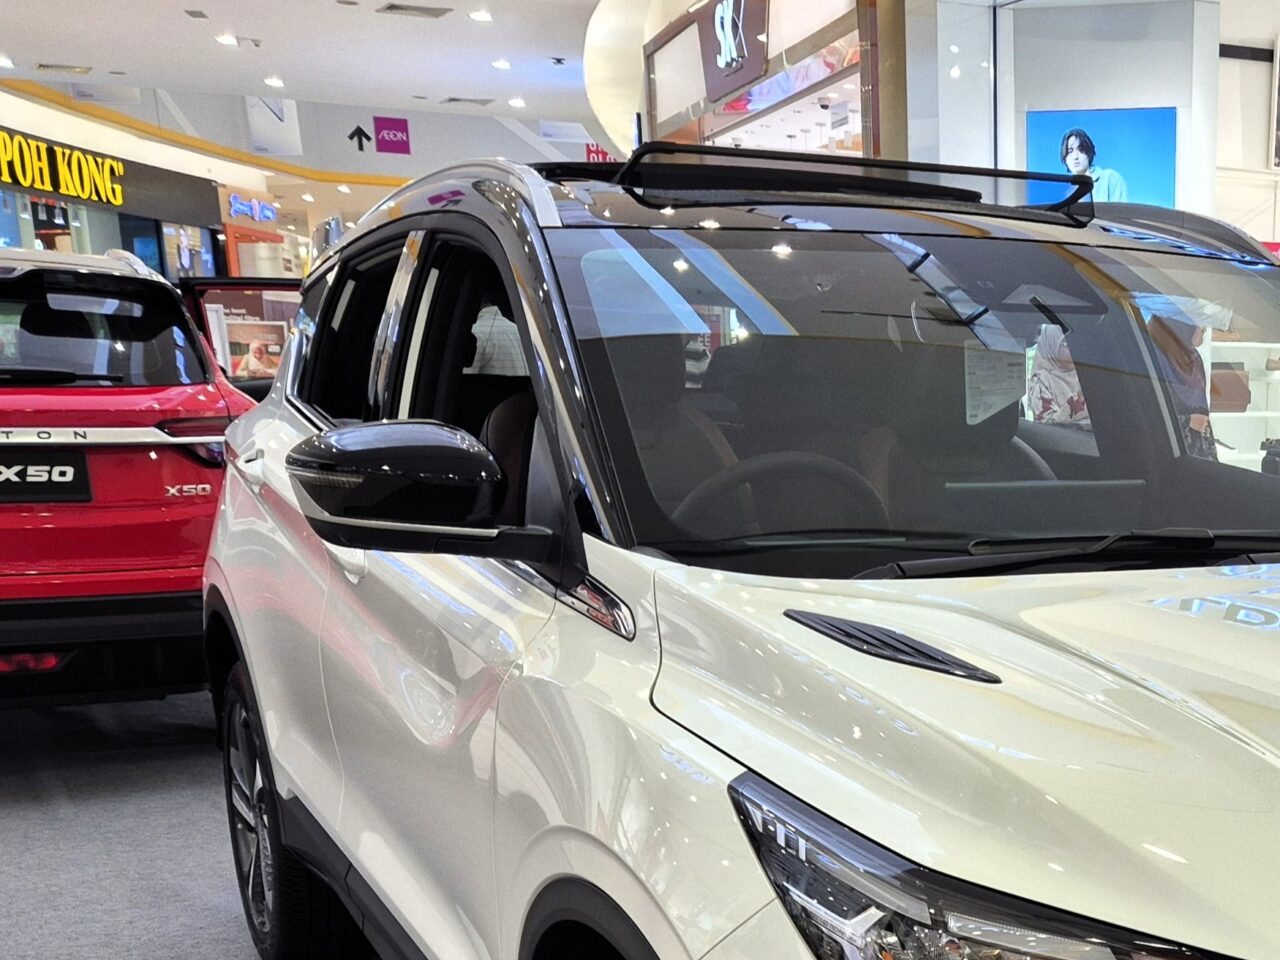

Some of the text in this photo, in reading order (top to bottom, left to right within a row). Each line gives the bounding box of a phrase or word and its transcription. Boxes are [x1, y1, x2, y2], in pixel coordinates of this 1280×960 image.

[0, 130, 123, 206] POH KONG
[0, 465, 75, 482] X50
[164, 484, 212, 497] X50
